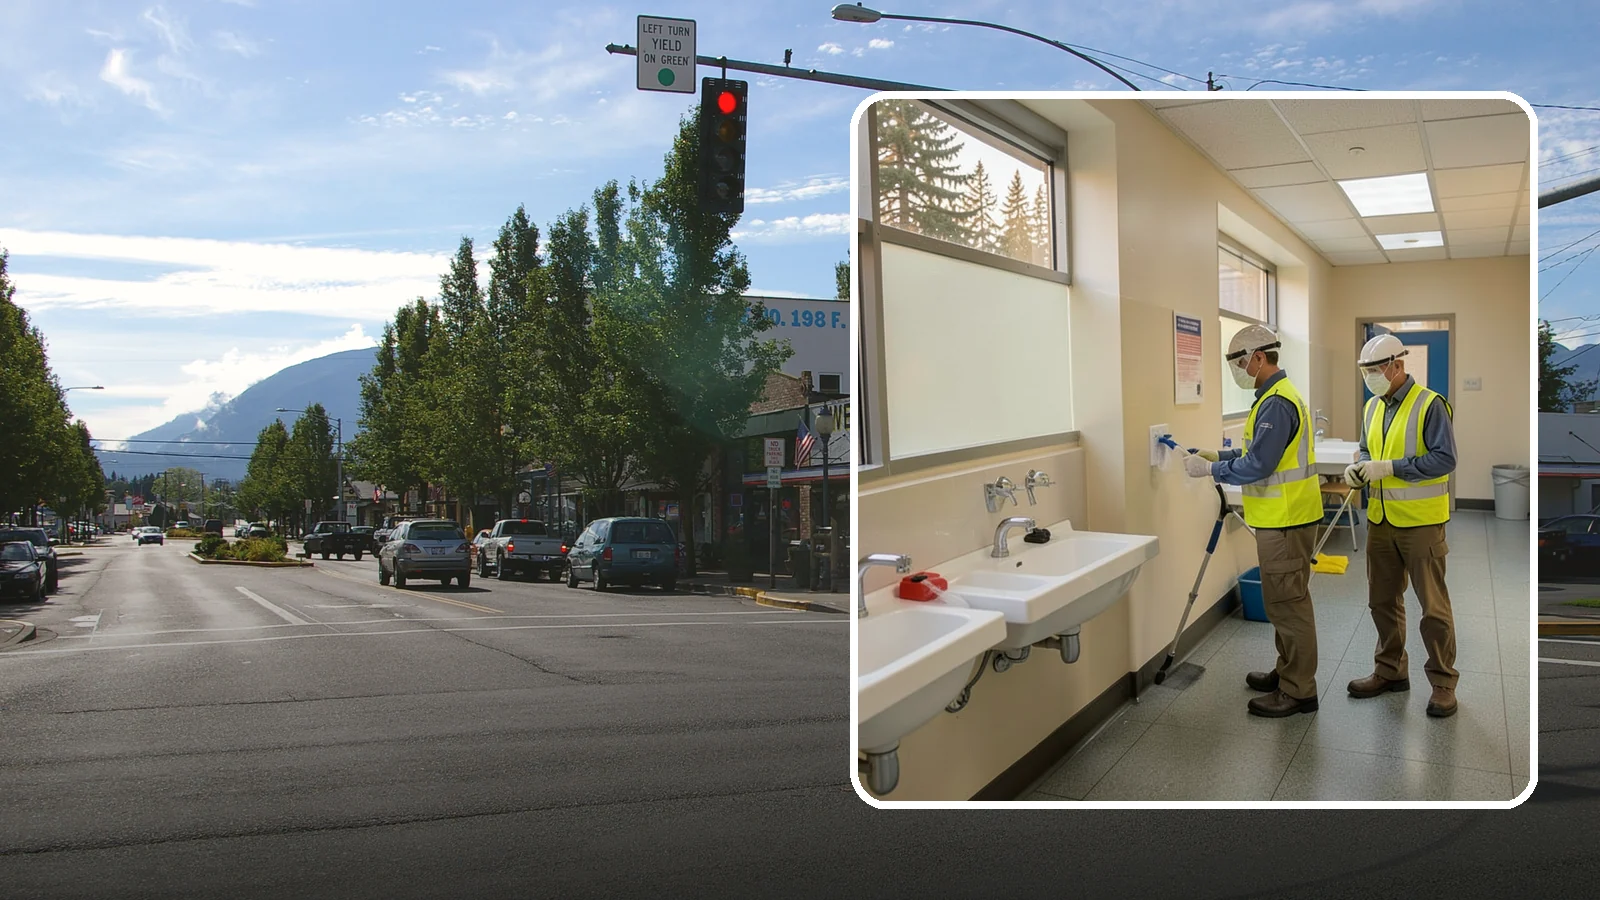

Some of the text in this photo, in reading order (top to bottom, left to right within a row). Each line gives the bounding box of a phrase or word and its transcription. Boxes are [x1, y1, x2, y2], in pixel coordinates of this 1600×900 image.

[643, 24, 690, 36] LEFT TURN
[652, 38, 682, 52] YIELD
[644, 53, 688, 66] ON GREEN
[792, 310, 826, 328] 198
[831, 312, 846, 328] F.
